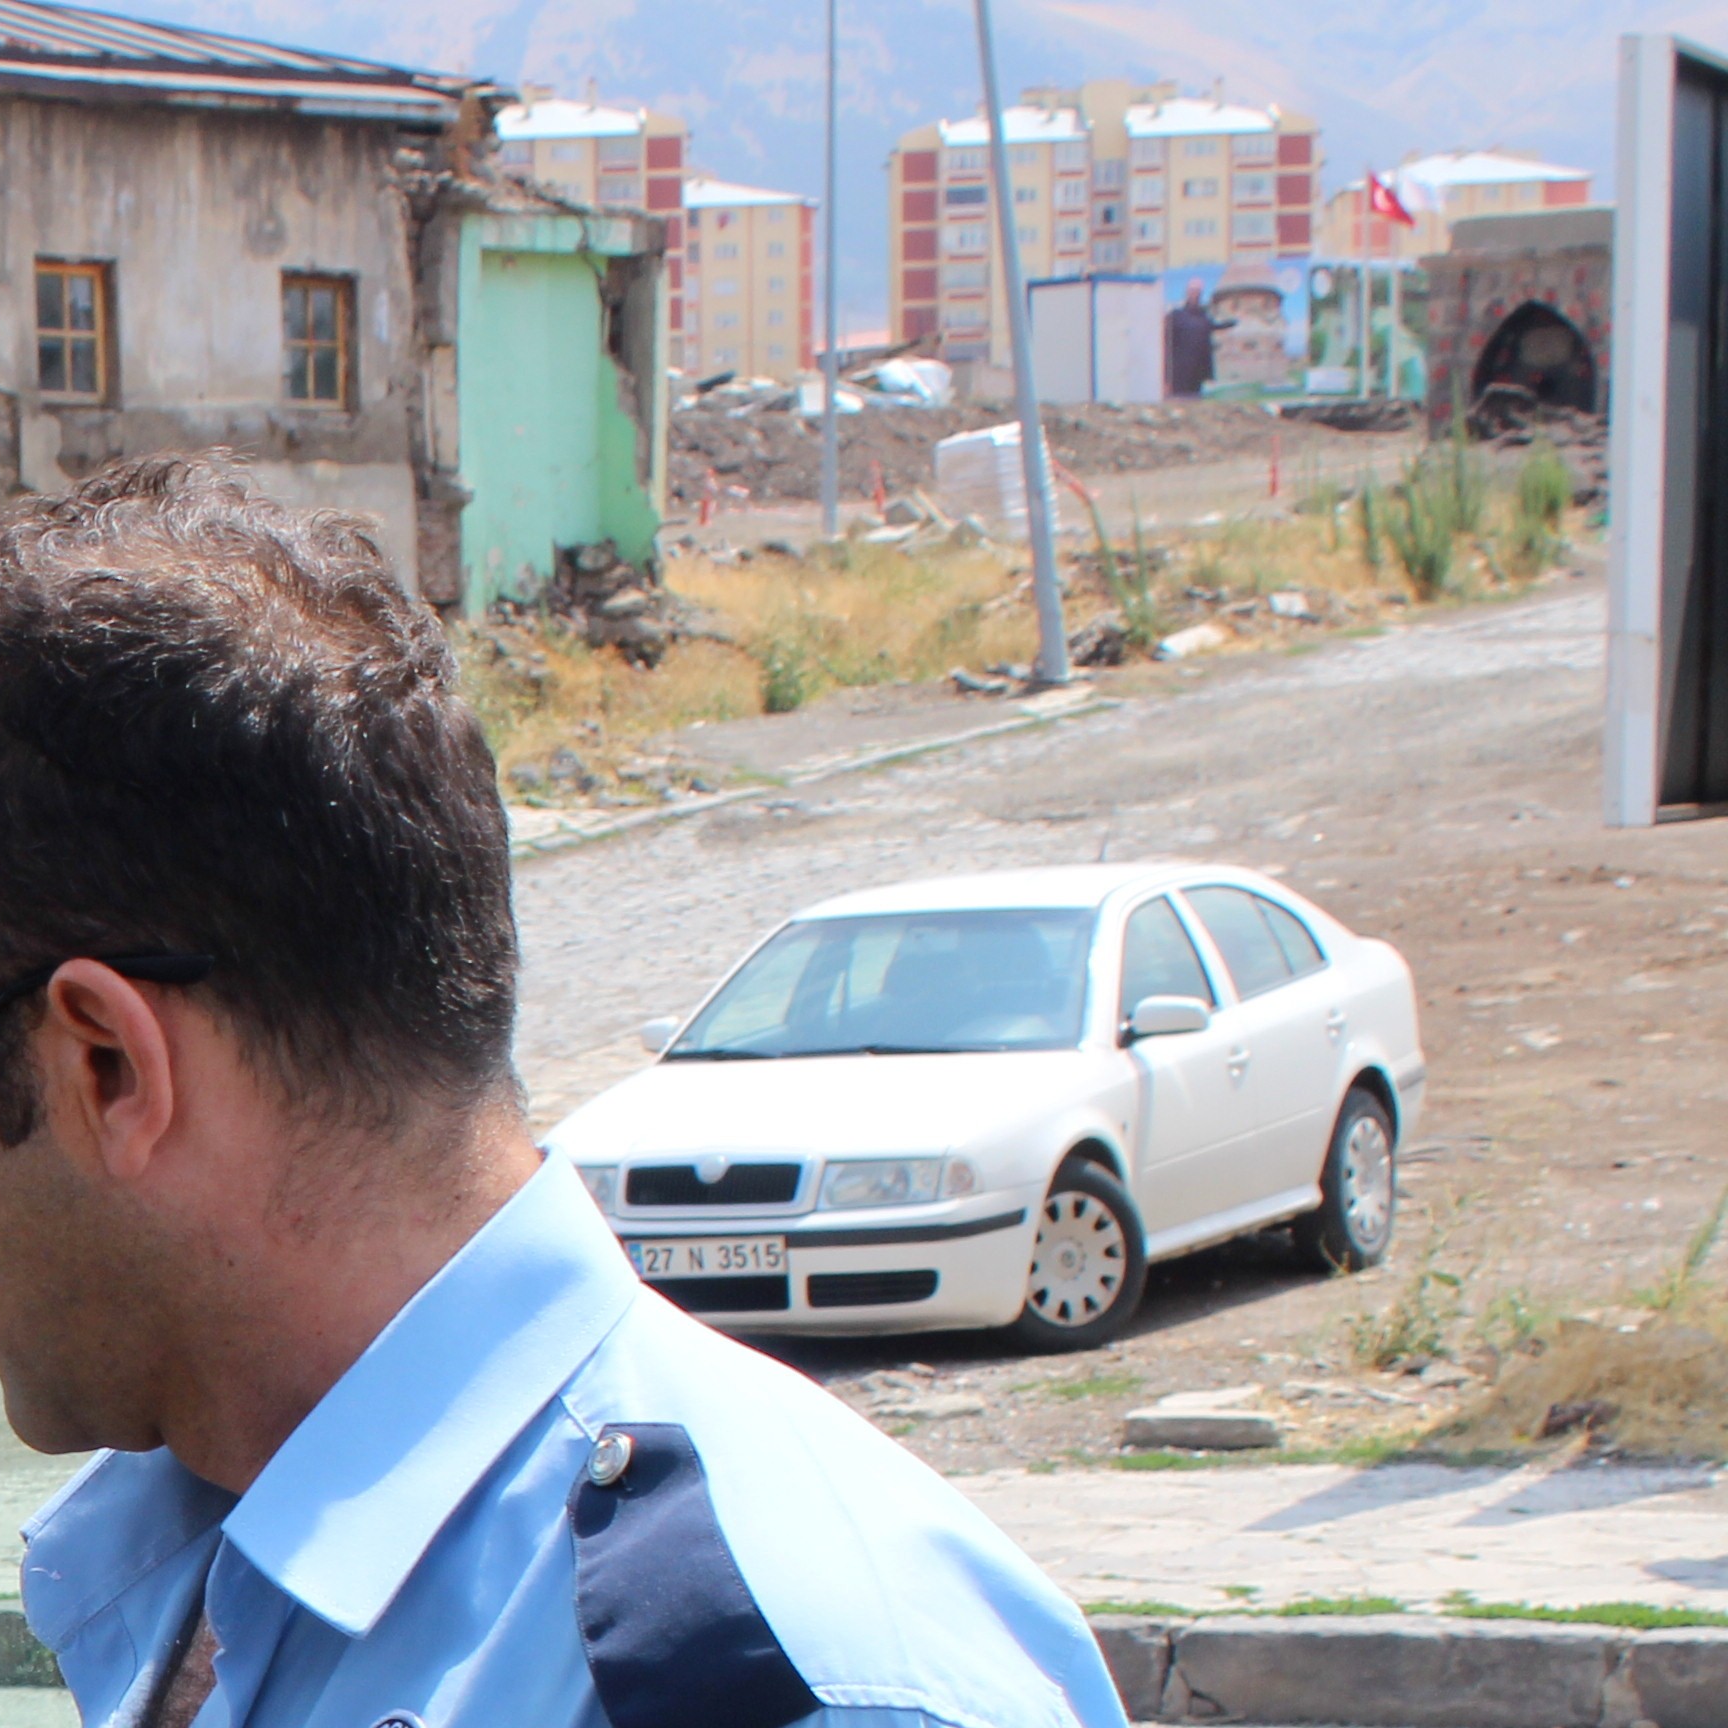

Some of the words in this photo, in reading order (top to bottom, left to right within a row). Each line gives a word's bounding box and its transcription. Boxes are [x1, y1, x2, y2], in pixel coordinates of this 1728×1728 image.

[646, 1248, 674, 1271] 27
[689, 1246, 704, 1269] N
[718, 1243, 781, 1268] 3515
